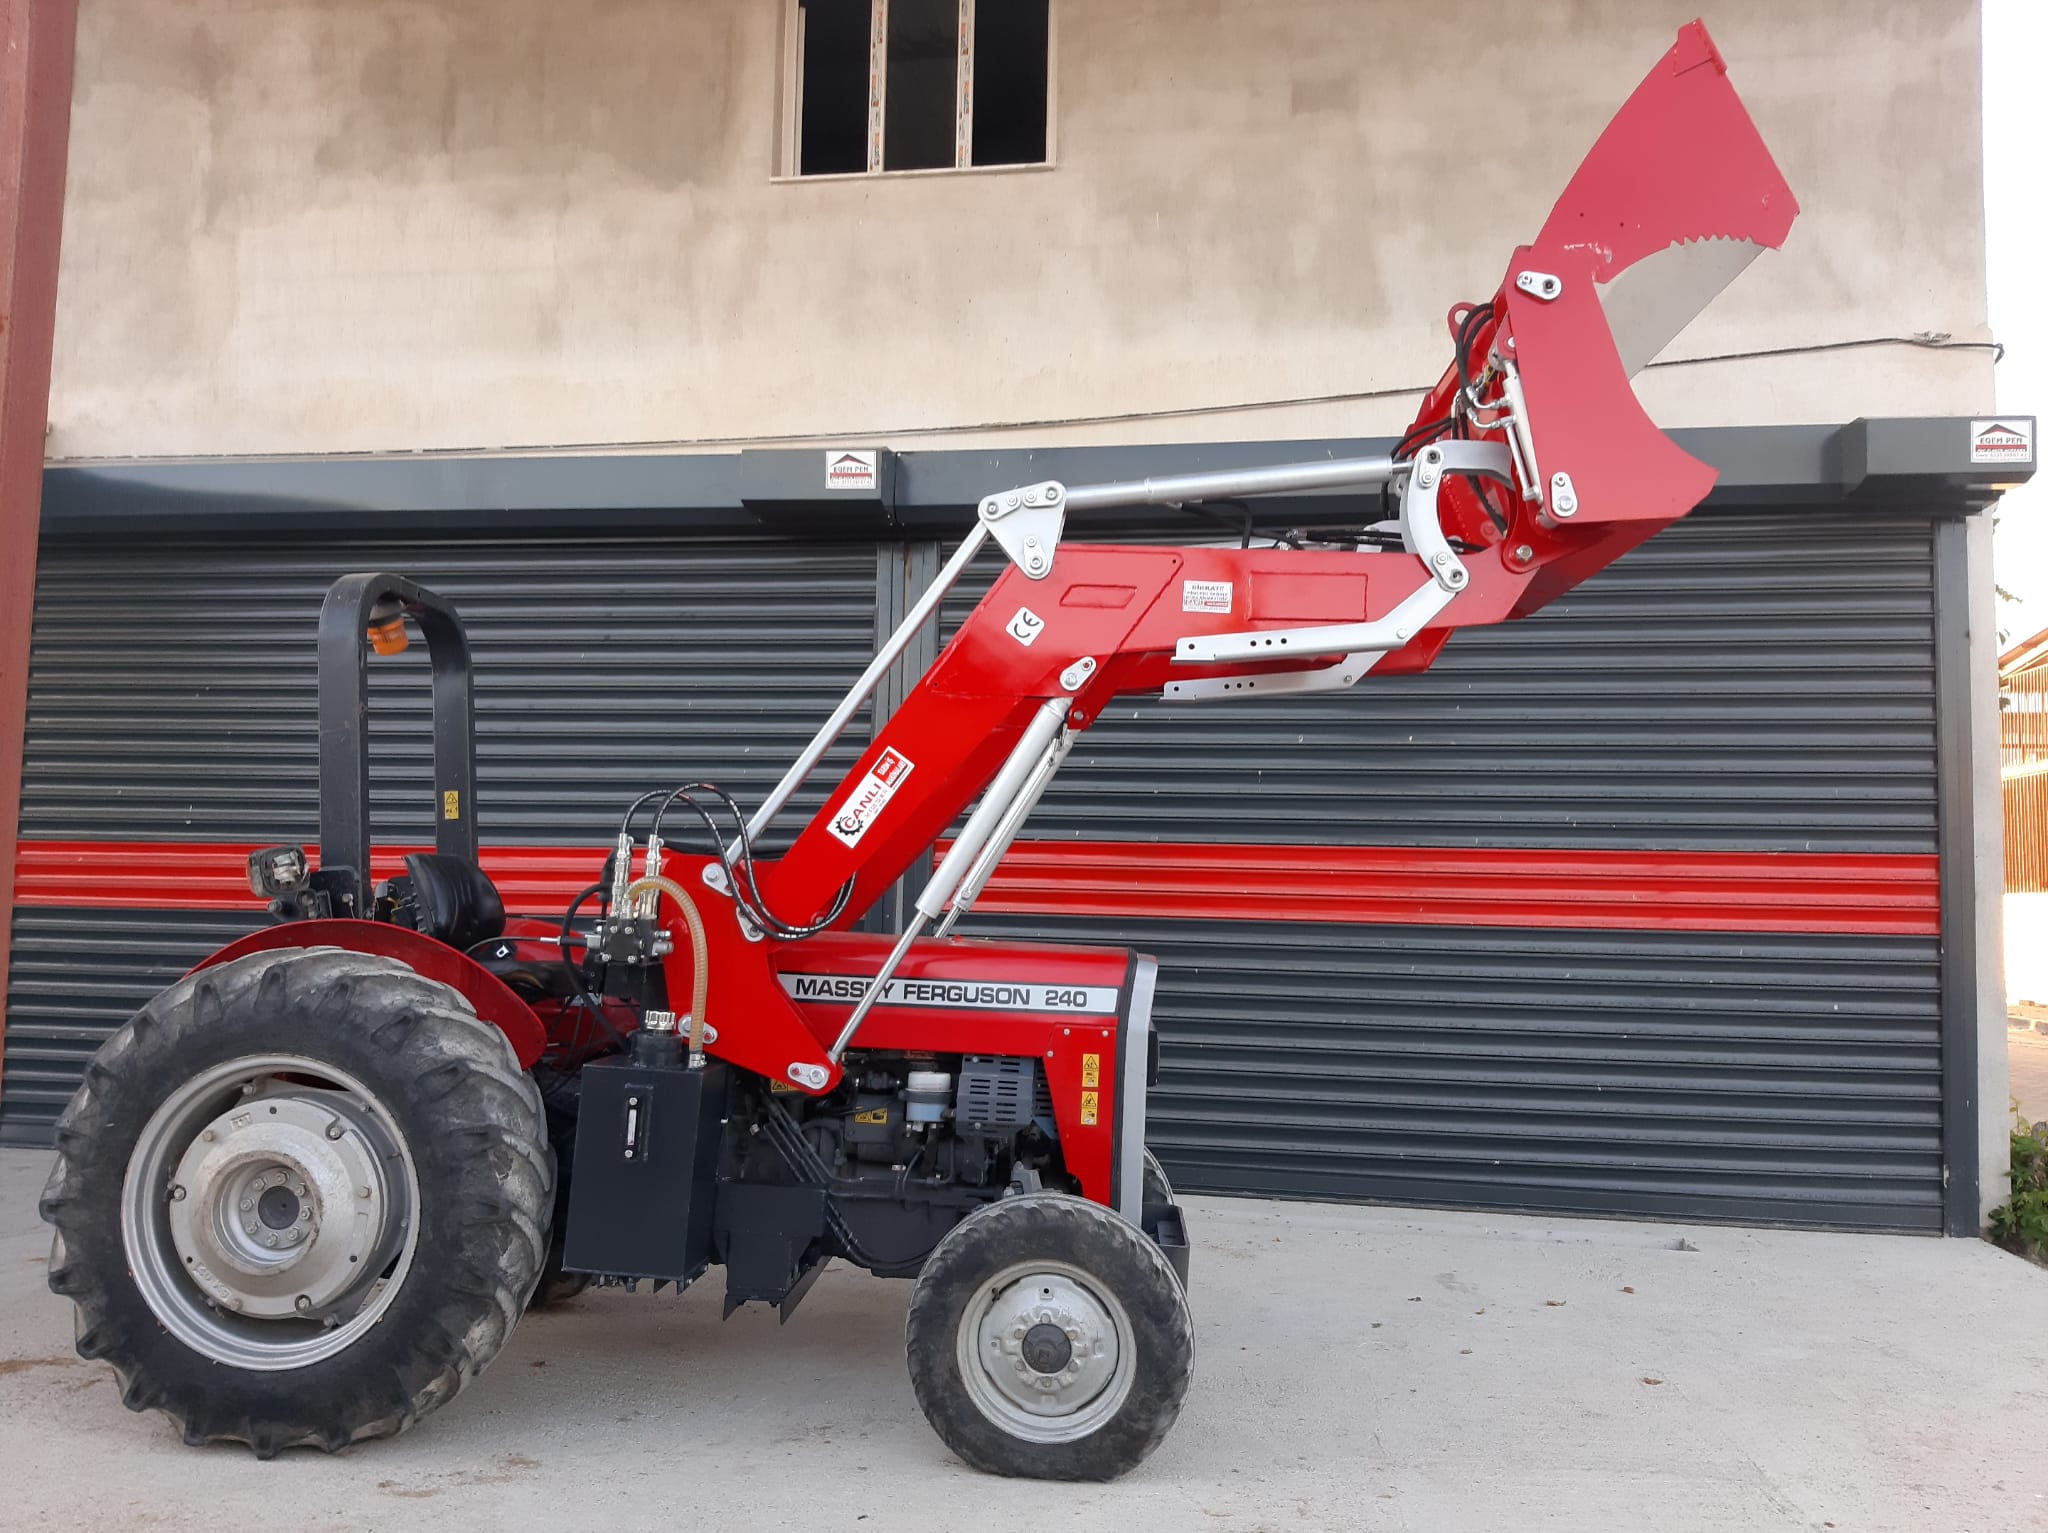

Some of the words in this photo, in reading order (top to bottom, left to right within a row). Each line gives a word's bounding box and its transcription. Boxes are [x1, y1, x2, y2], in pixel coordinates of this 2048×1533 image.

[1013, 611, 1040, 638] CE
[844, 782, 882, 829] CANLI
[903, 983, 1031, 1006] FERGUSON
[1045, 989, 1088, 1008] 240
